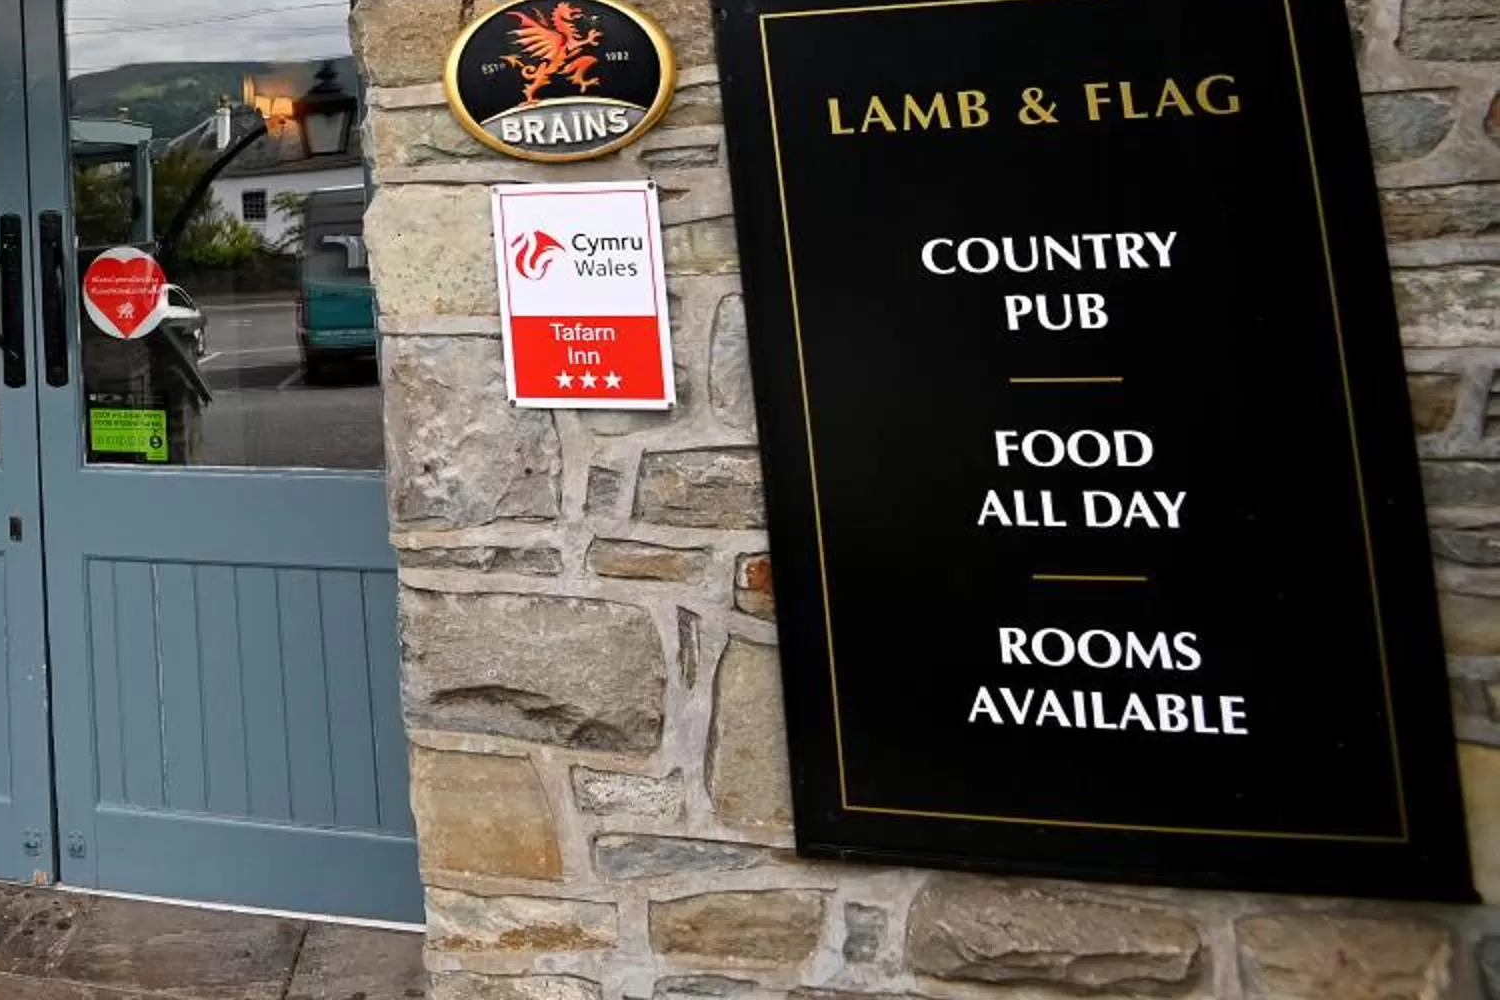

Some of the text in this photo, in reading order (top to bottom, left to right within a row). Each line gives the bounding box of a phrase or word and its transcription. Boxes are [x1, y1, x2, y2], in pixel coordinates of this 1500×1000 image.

[827, 74, 1241, 135] LAMB & FLAG
[501, 108, 629, 144] BRAINS
[571, 233, 643, 256] Cymru
[921, 231, 1177, 275] COUNTRY
[574, 259, 638, 277] Wales
[1004, 293, 1109, 331] PUB
[550, 323, 616, 341] Tafarn
[567, 347, 601, 364] Inn
[995, 430, 1153, 467] FOOD
[977, 490, 1187, 528] ALL DAY
[999, 627, 1201, 671] ROOMS
[968, 686, 1248, 735] AVAILABLE
